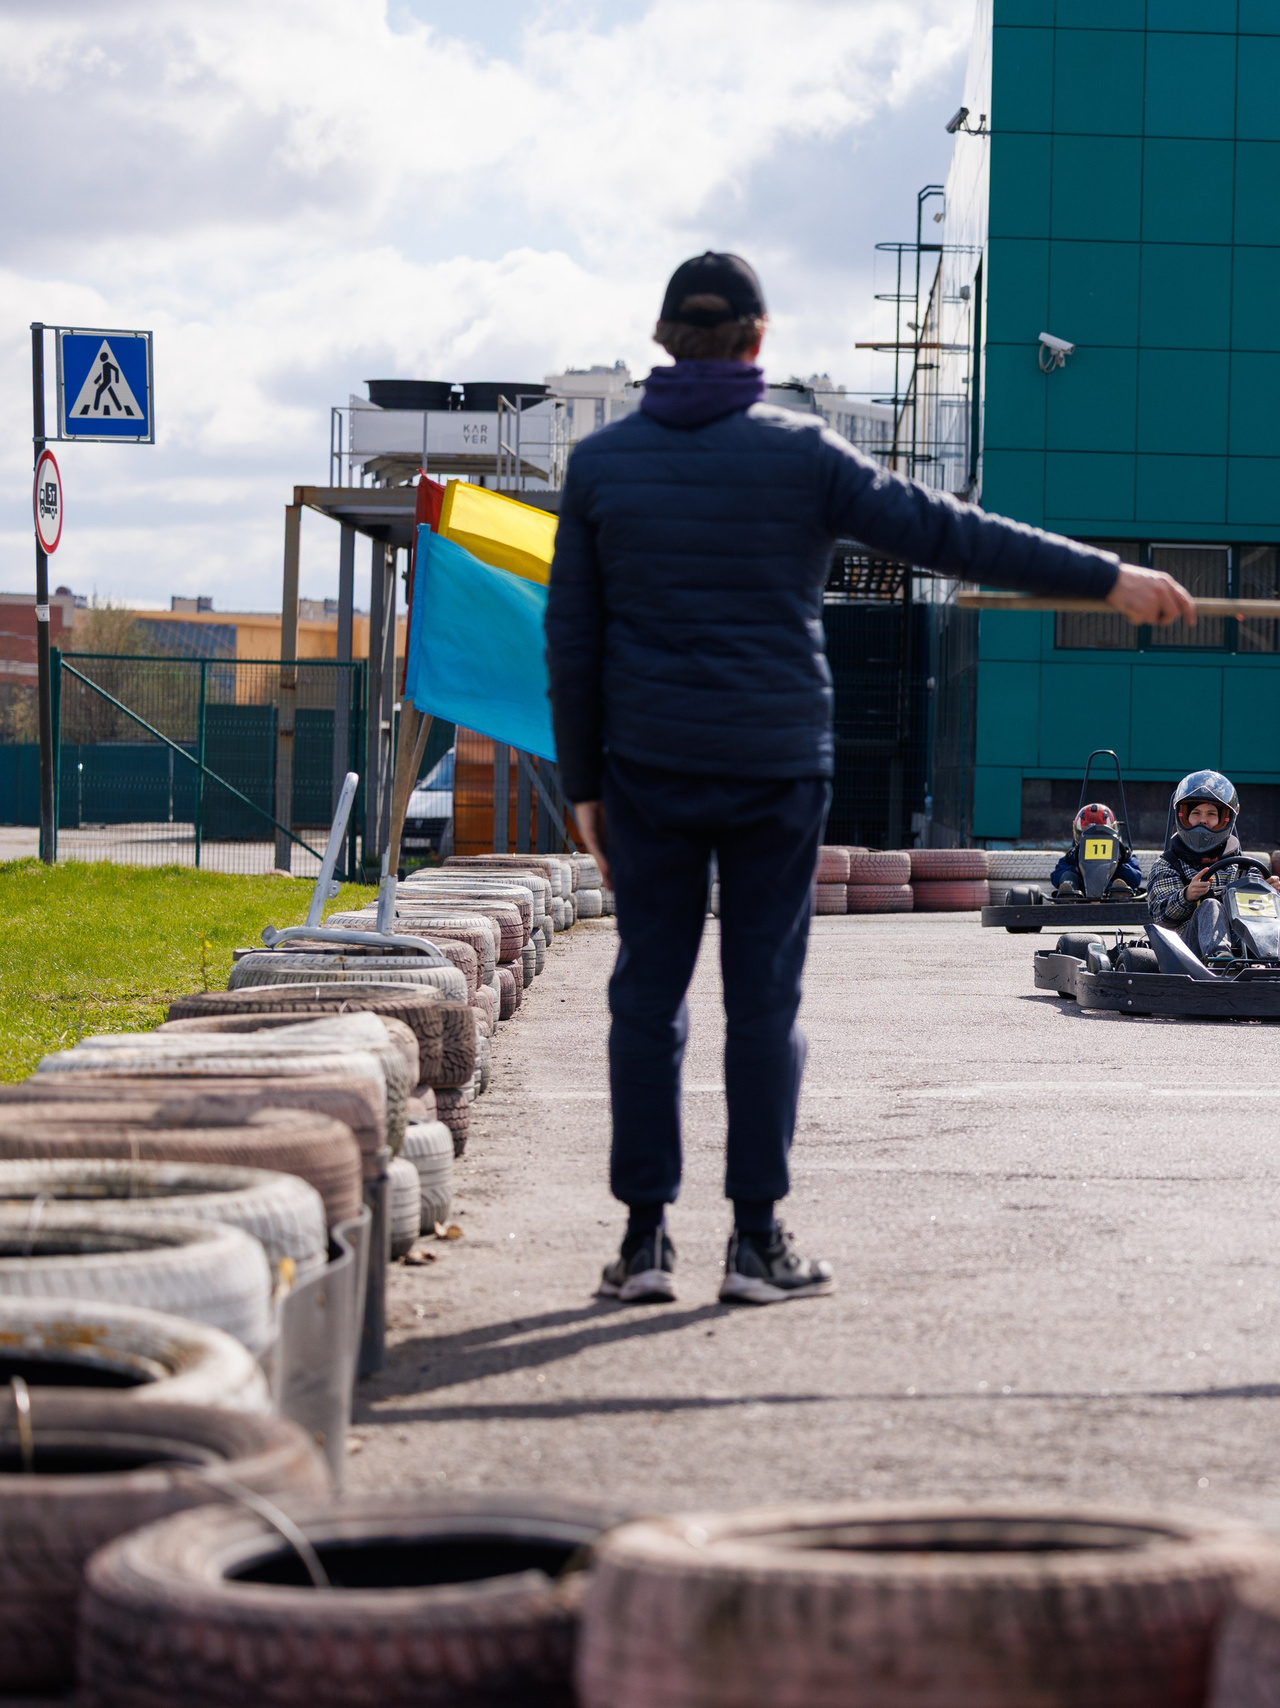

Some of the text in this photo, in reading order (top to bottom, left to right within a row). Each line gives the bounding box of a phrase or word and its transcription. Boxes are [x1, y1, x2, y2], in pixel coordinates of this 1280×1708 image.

[463, 424, 488, 434] KAR
[463, 434, 488, 444] YER
[1092, 844, 1106, 855] 11
[1248, 899, 1265, 911] 5
